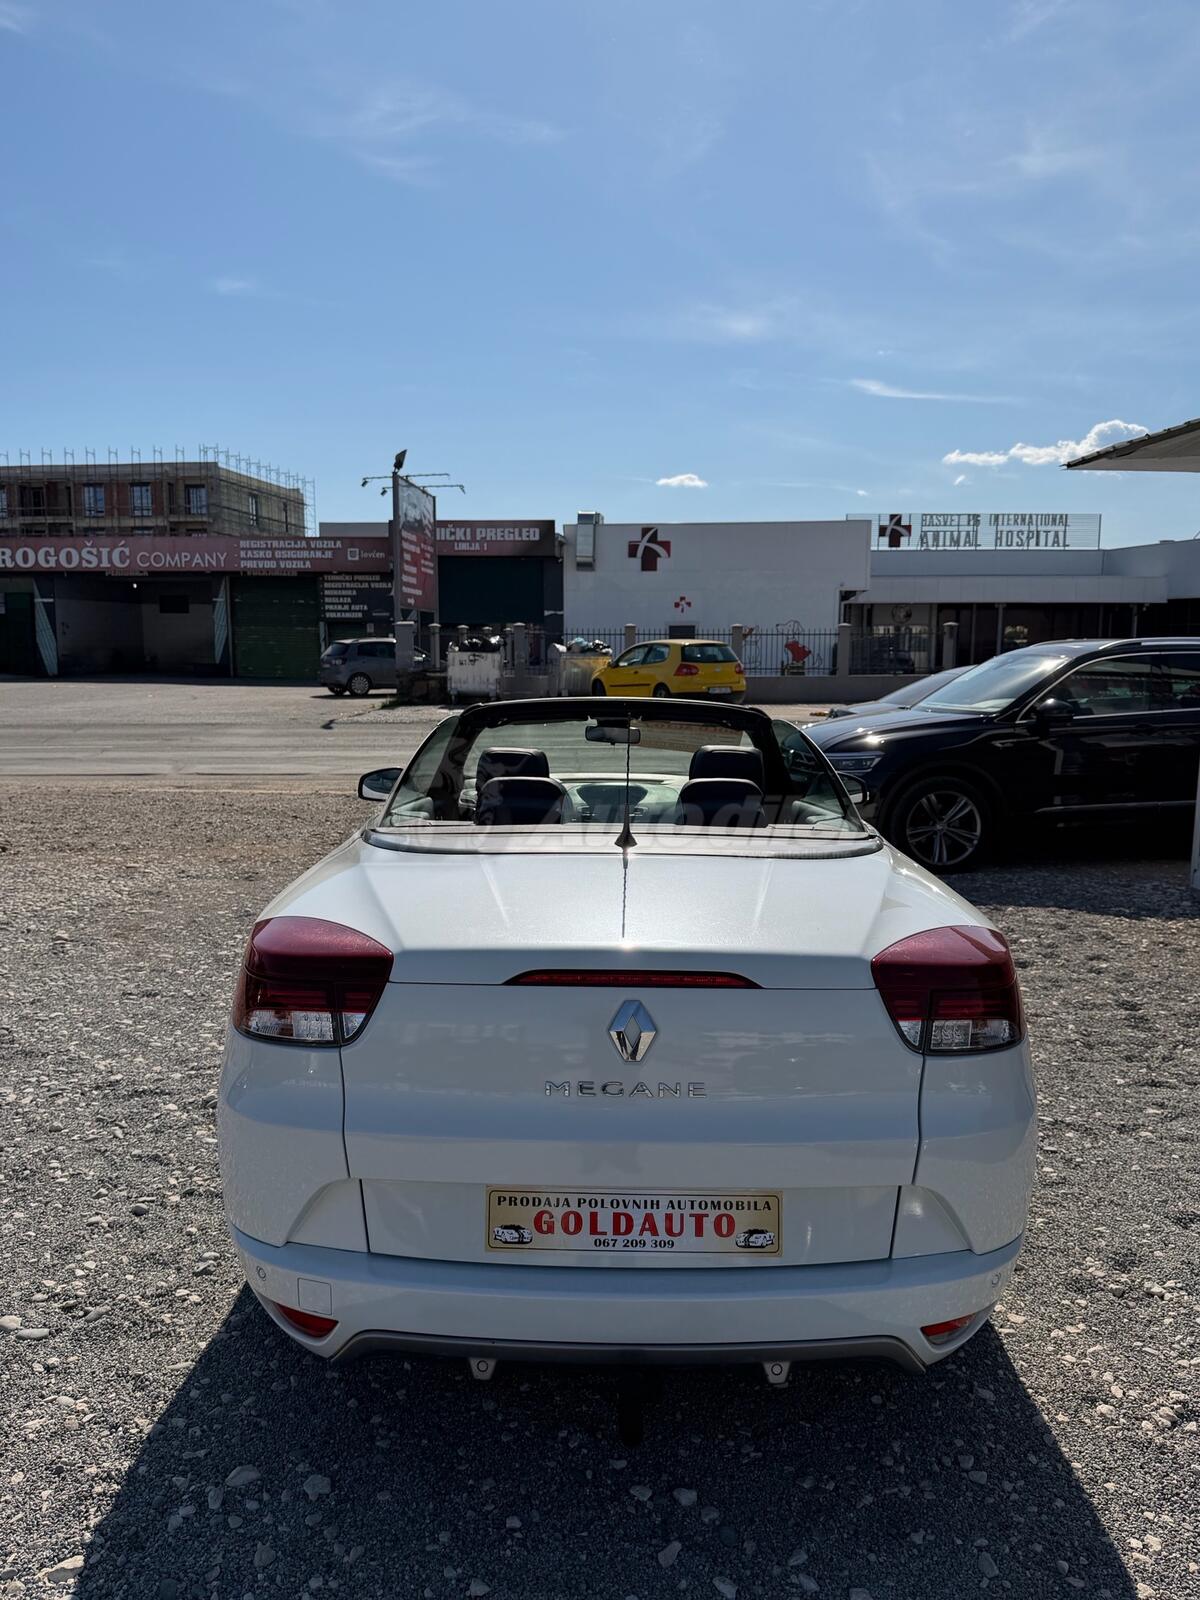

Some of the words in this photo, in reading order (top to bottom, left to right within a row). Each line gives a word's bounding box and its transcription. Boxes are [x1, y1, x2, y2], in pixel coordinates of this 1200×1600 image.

[989, 513, 1070, 527] INTERNATIONAL
[476, 527, 540, 541] PREGLED
[919, 530, 981, 547] ANIMAL
[995, 530, 1070, 547] HOSPITAL
[240, 540, 307, 549] REGISTRACIJA
[311, 540, 343, 549] VOZILA
[454, 542, 480, 551] LINIJA
[481, 542, 488, 551] 1
[137, 551, 228, 568] COMPANY
[240, 550, 272, 559] KASKO
[275, 550, 334, 559] OSIGURANJE
[280, 560, 312, 569] VOZILA
[544, 1080, 708, 1099] MEGANE
[497, 1195, 571, 1208] PRODAJA
[577, 1197, 661, 1210] POLOVNIH
[667, 1199, 772, 1212] AUTOMOBILA
[533, 1210, 736, 1238] GOLDAUTO
[594, 1238, 619, 1248] 067
[622, 1239, 647, 1248] 209
[651, 1239, 675, 1249] 309
